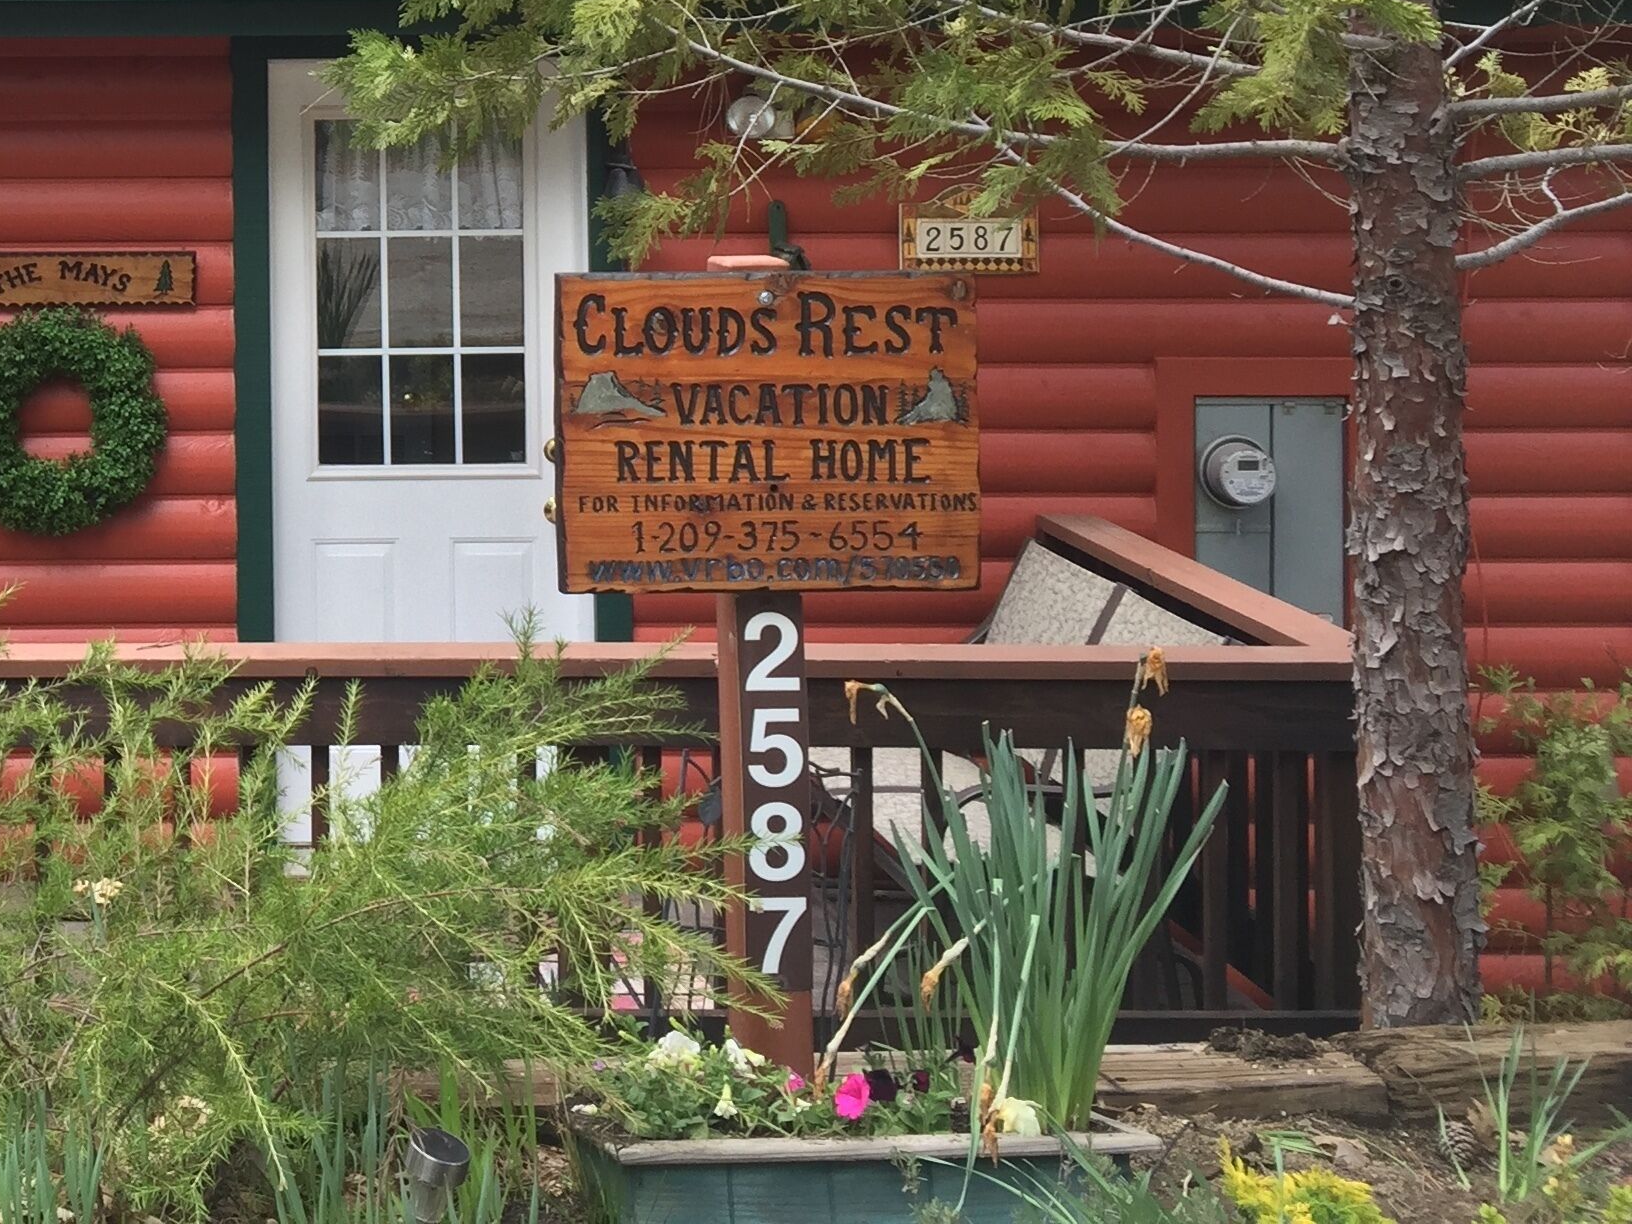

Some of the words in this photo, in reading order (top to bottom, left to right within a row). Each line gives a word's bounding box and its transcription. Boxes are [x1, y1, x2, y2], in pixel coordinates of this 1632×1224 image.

[925, 226, 1014, 252] 2587
[58, 260, 132, 293] MAYS
[670, 382, 890, 426] VACATION
[615, 439, 792, 484] RENTAL
[810, 438, 932, 484] HOME
[578, 495, 619, 514] FOR
[631, 493, 795, 514] INFORMATION
[802, 494, 818, 512] &
[823, 492, 977, 512] RESERVATIONS
[743, 611, 808, 975] 2587
